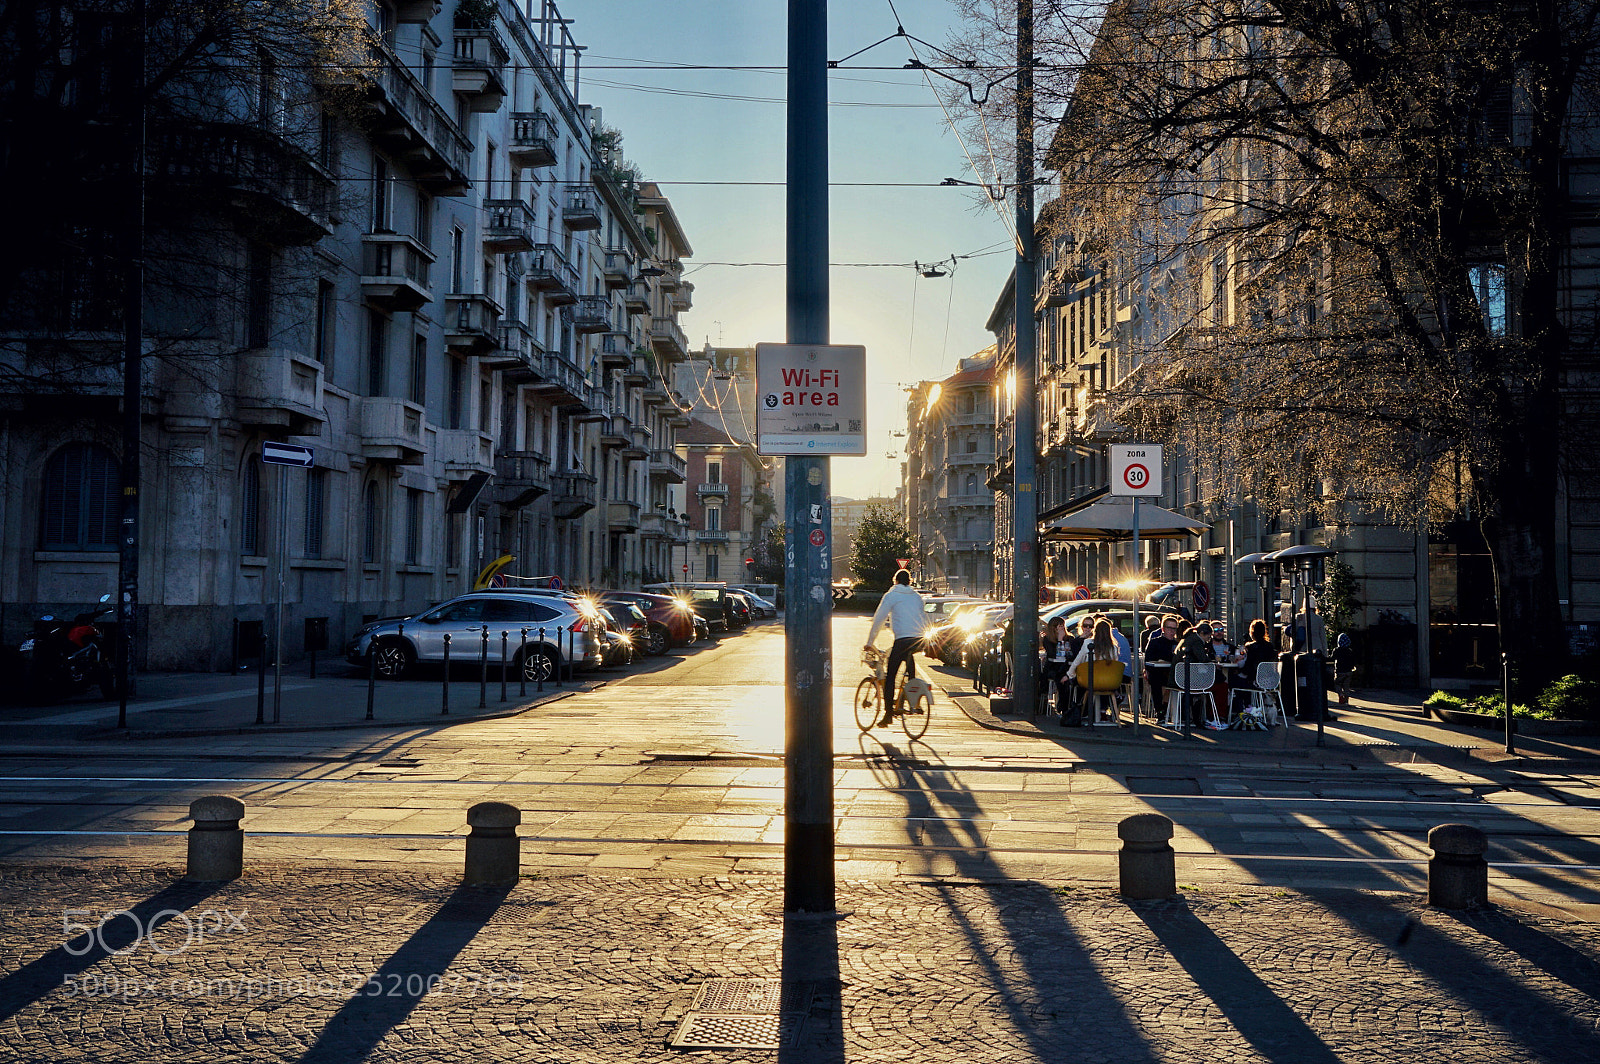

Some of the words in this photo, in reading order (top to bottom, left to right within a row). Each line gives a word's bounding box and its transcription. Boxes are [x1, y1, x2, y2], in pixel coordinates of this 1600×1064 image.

[781, 368, 839, 388] Wi-Fi
[782, 391, 839, 406] area
[1130, 471, 1143, 482] 30
